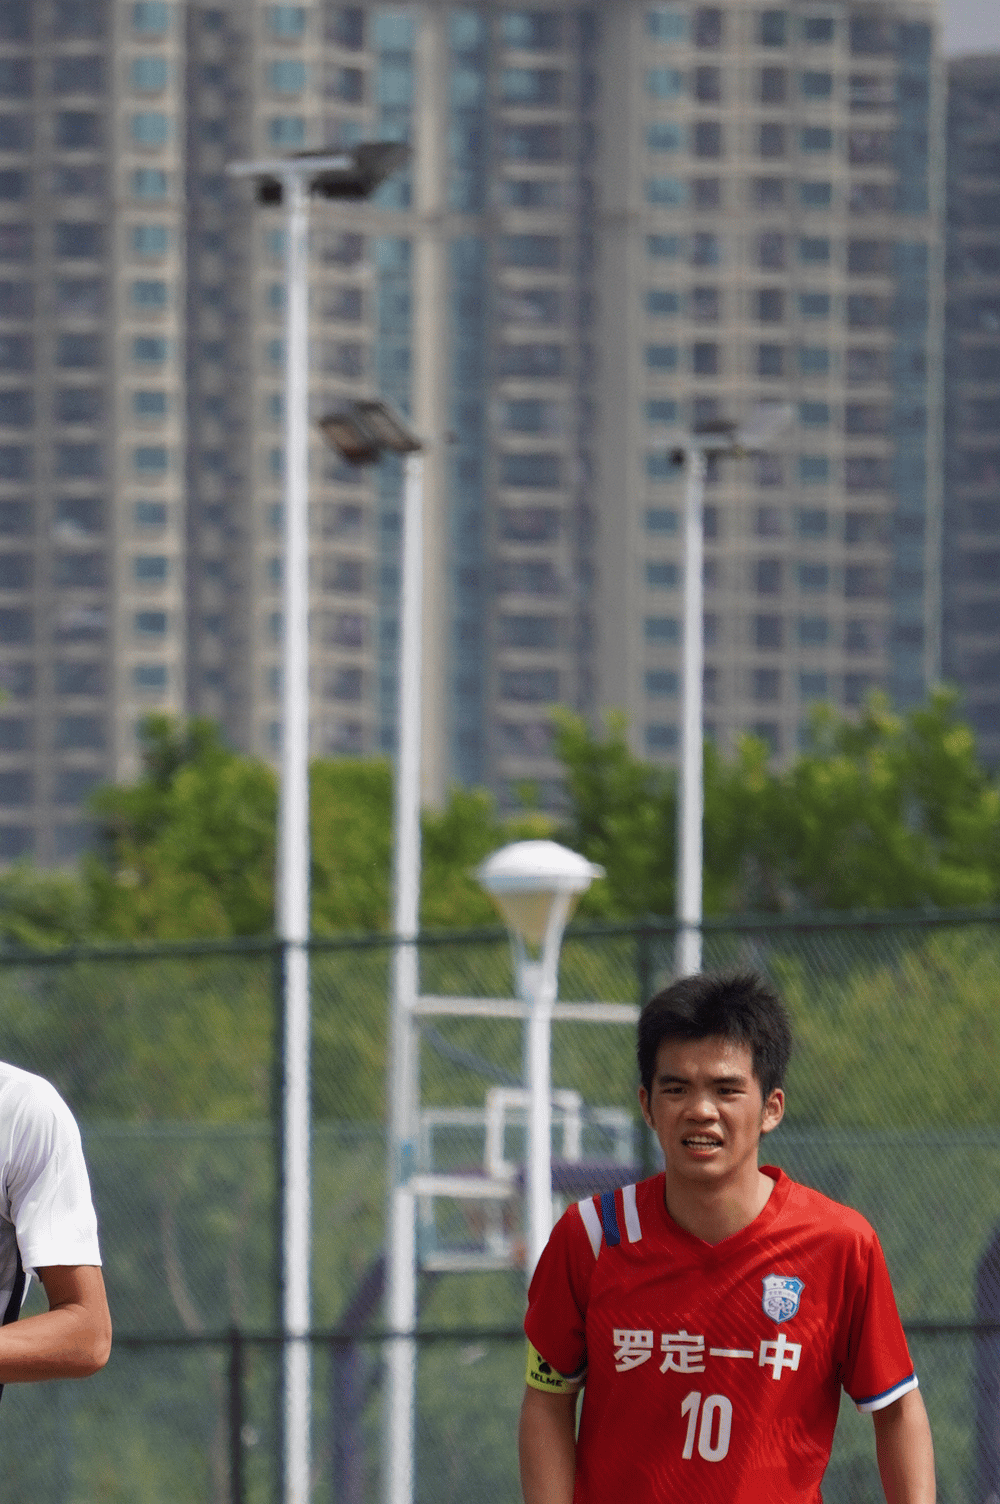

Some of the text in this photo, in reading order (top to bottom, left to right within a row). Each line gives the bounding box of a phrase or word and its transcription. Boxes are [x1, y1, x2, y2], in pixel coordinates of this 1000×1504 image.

[530, 1371, 564, 1388] KELME
[612, 1328, 802, 1381] 罗定一中
[681, 1391, 733, 1463] 10
